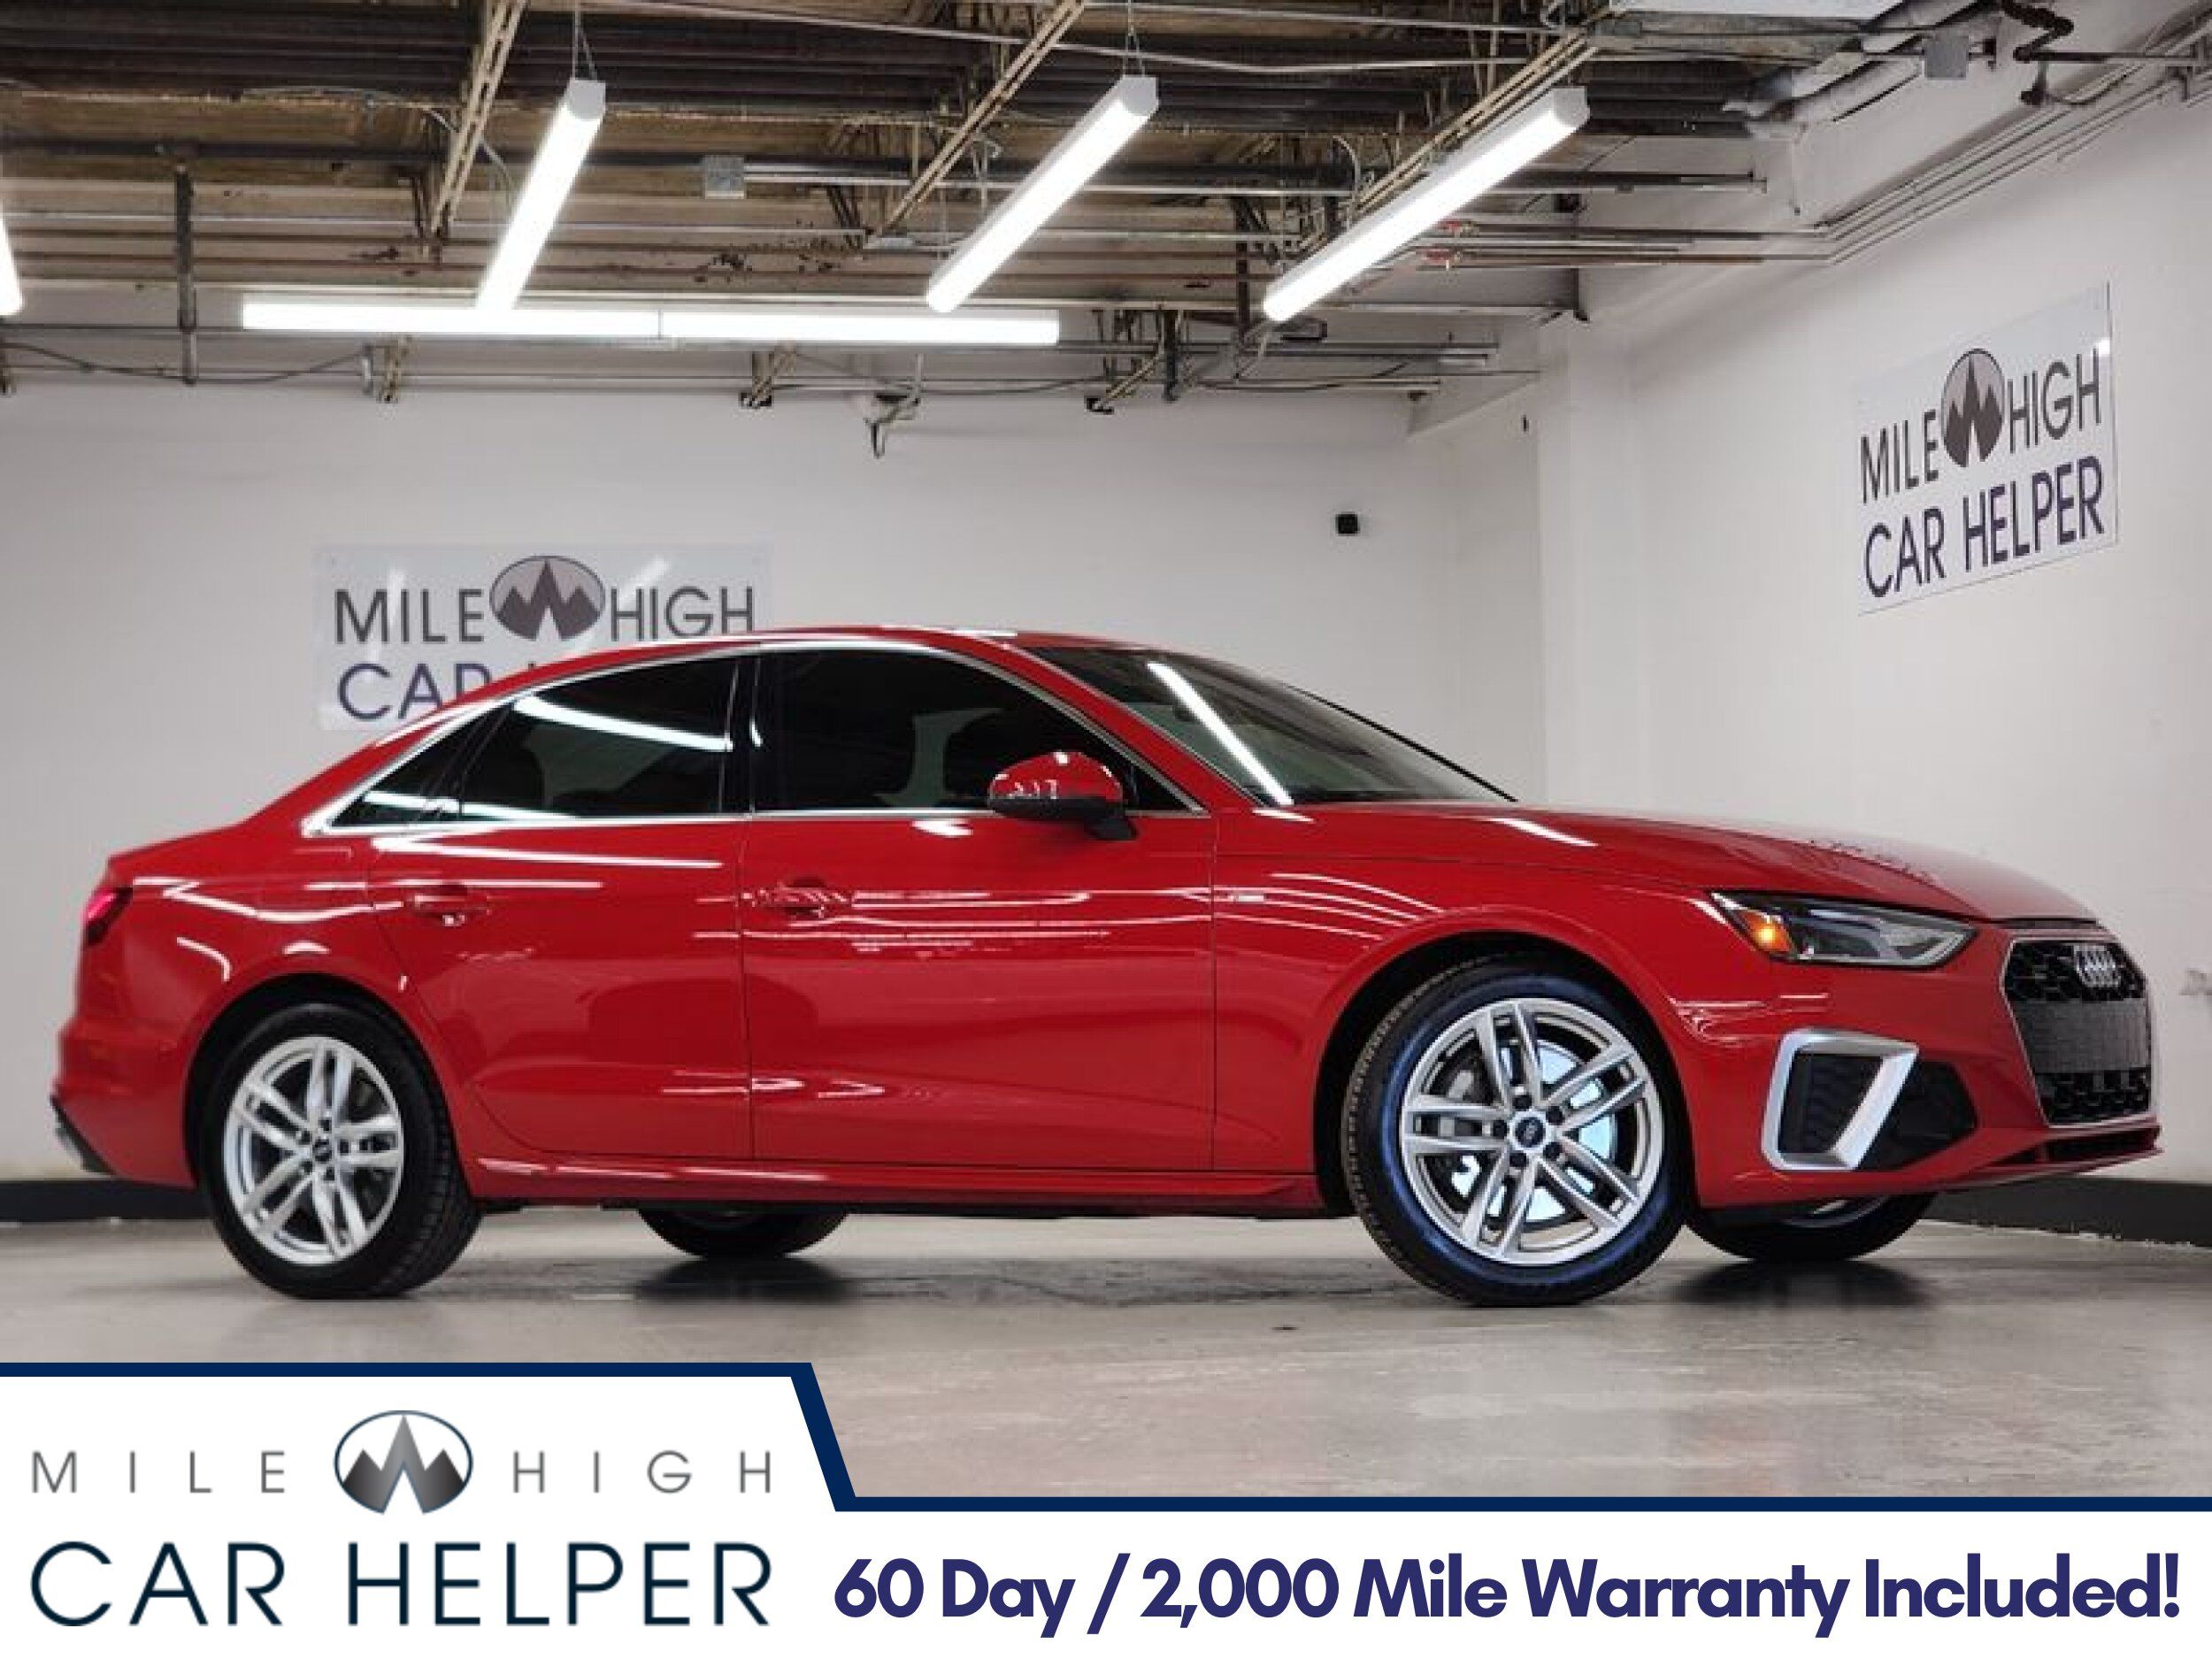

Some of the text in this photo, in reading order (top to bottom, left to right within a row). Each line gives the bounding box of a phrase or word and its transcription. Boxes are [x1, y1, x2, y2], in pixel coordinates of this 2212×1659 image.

[1860, 348, 2101, 505] MILE HIGH
[1864, 455, 2105, 598] CAR HELPER
[334, 586, 754, 644] MILE HIGH
